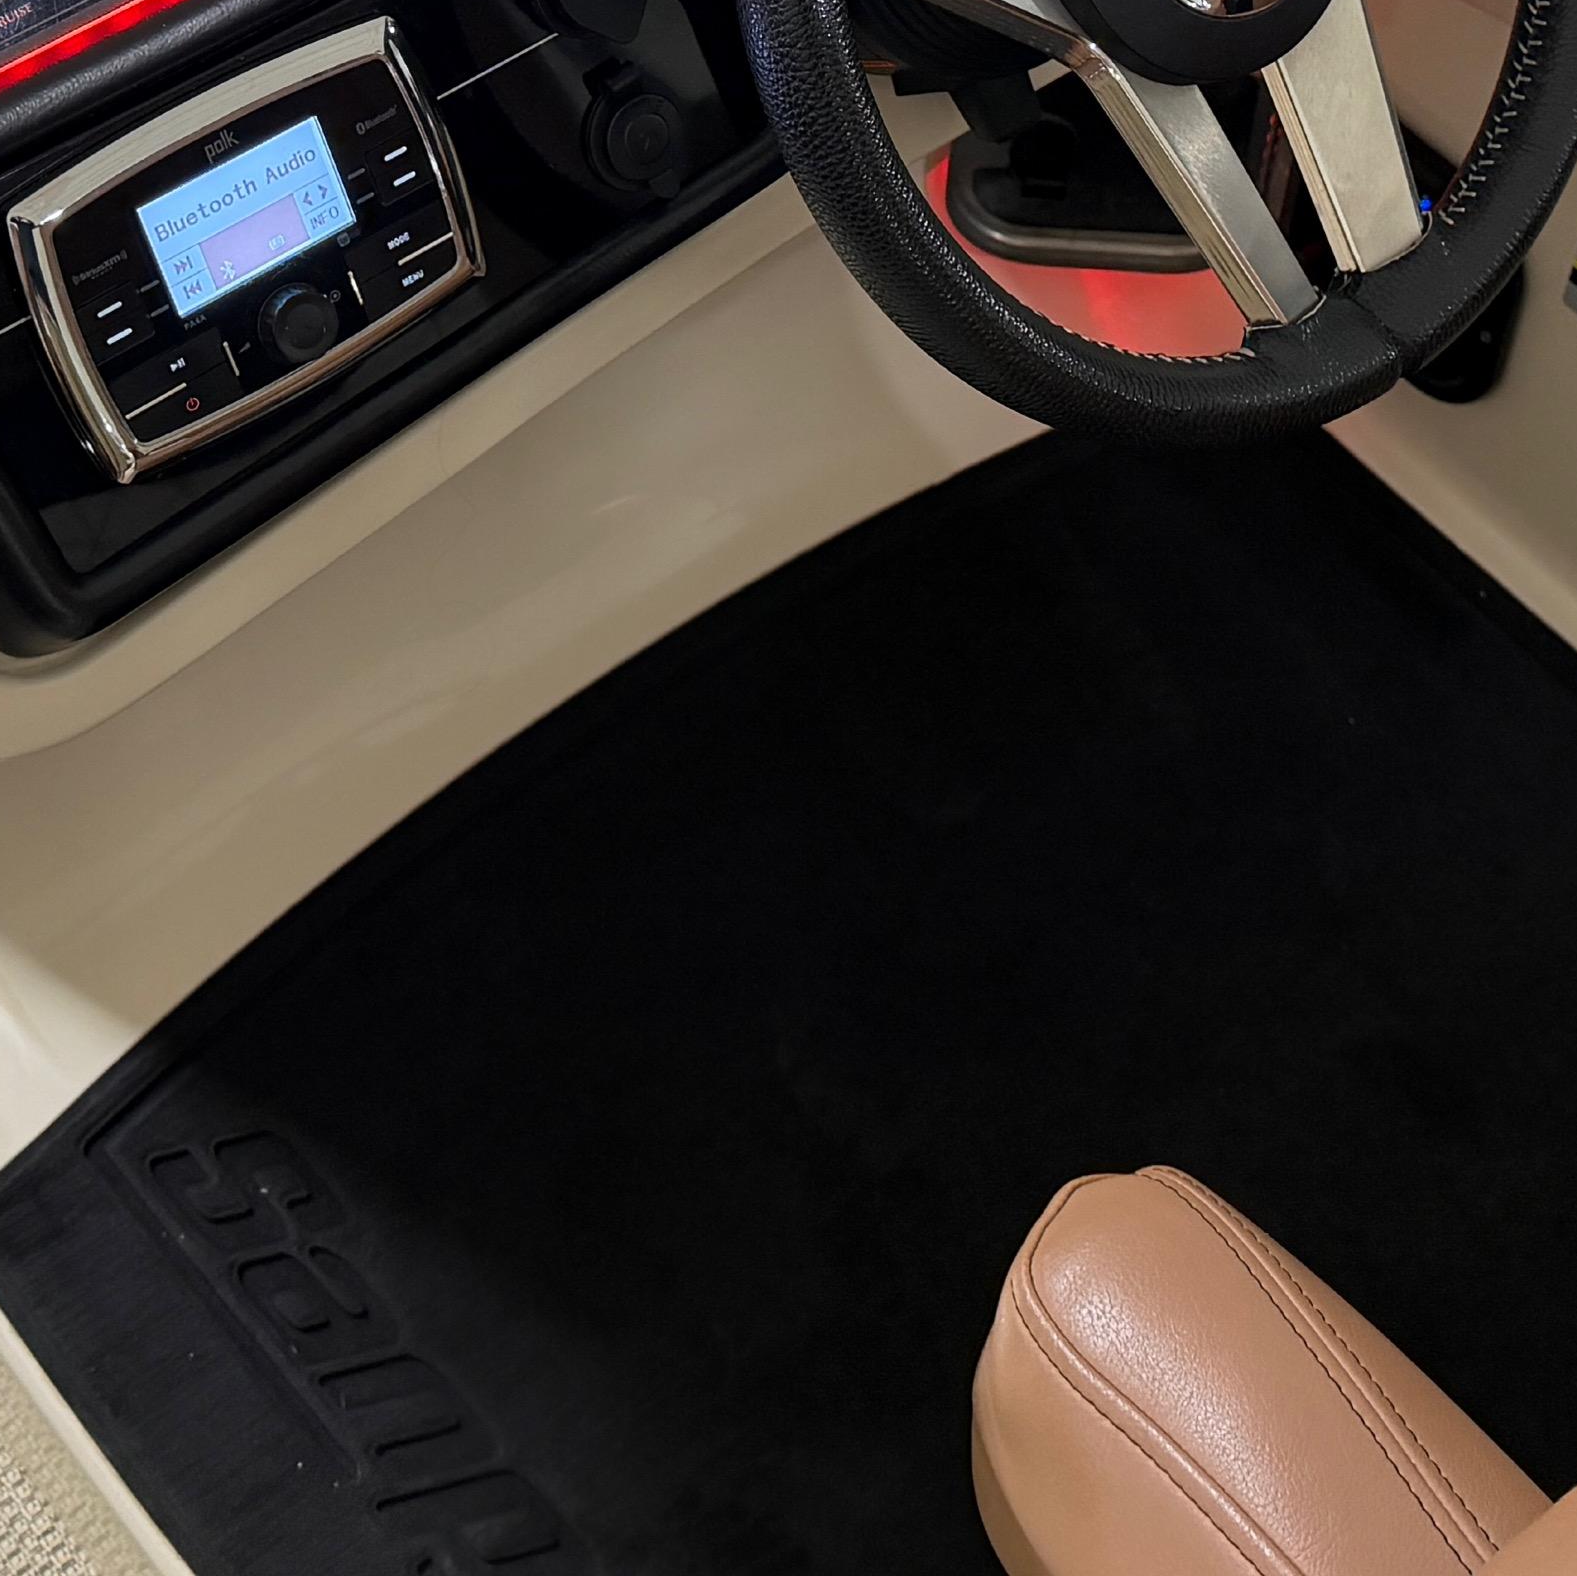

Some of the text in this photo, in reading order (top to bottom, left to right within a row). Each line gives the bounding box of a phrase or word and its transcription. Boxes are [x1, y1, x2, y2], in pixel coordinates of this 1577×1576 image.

[204, 129, 240, 164] polk
[154, 146, 317, 243] Bluetooth Audio
[309, 204, 340, 230] INFO
[387, 232, 411, 250] MODE
[402, 269, 425, 286] MENU
